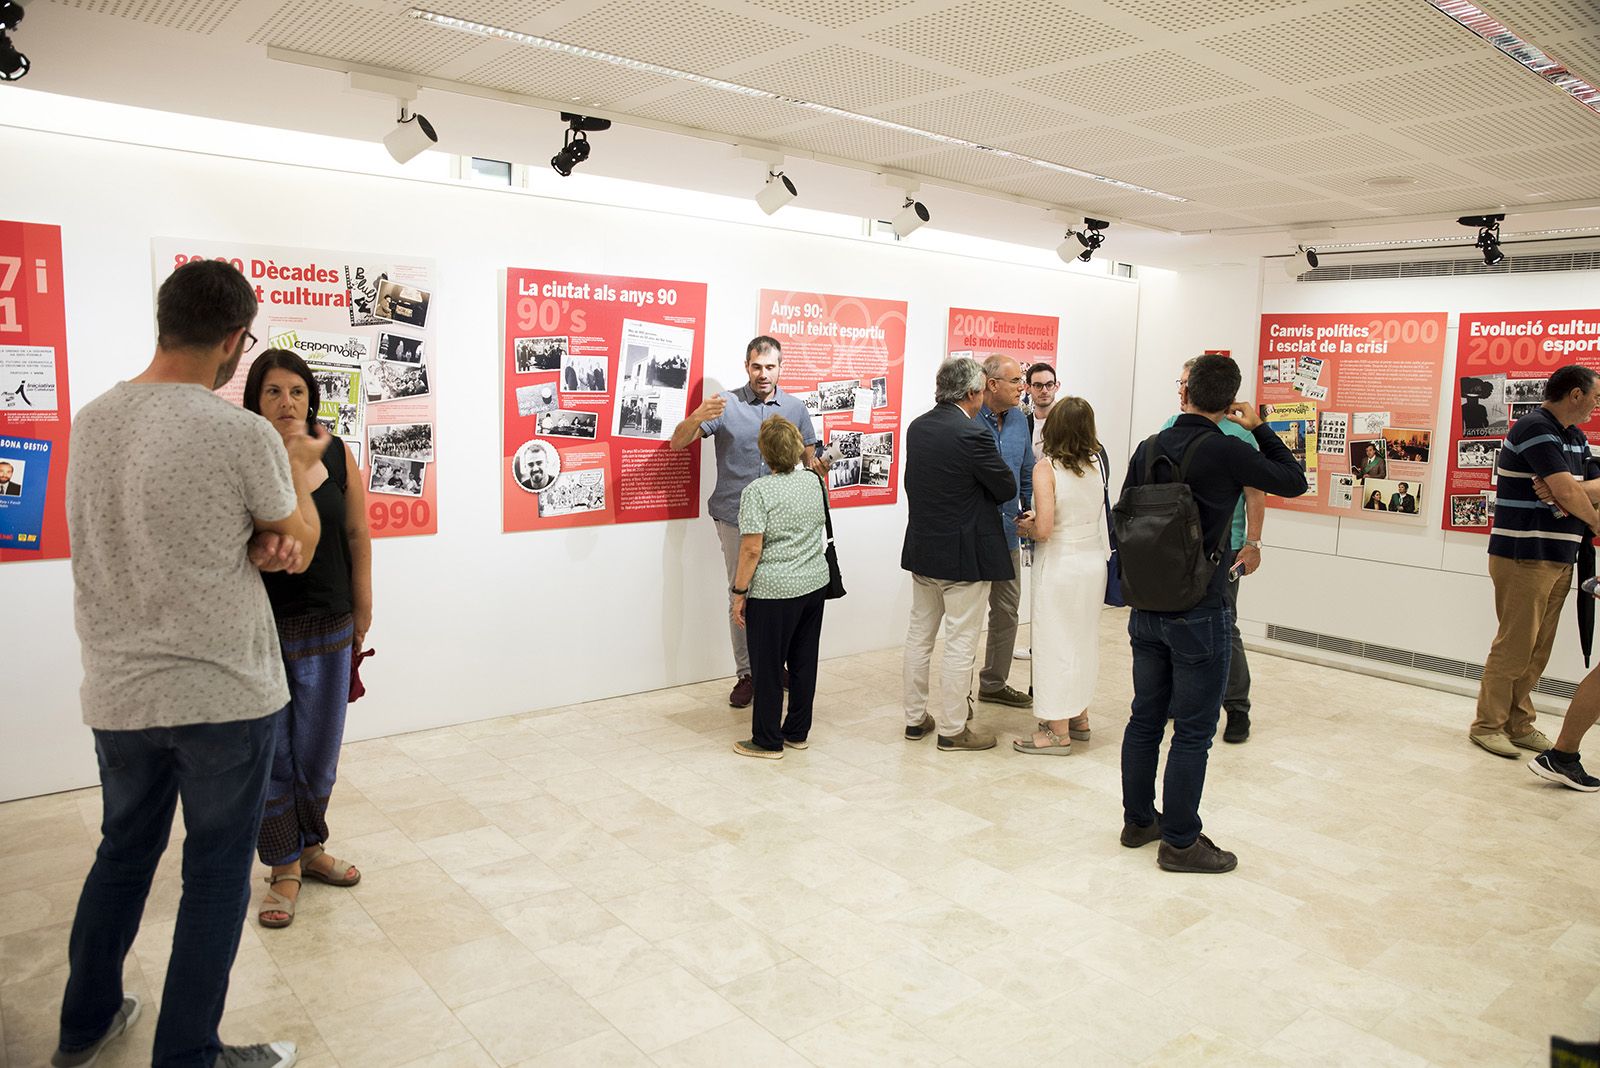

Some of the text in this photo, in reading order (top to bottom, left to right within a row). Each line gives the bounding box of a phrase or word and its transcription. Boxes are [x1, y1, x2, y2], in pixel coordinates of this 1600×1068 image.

[35, 258, 48, 294] i
[251, 259, 339, 284] Dècades
[270, 286, 351, 308] cultural
[518, 278, 678, 307] La ciutat als anys 90
[517, 297, 587, 334] 90's
[771, 301, 823, 320] Anys 90:
[769, 319, 885, 341] Ampli teixit esportiu
[953, 314, 1054, 338] 2000 Entre Internet i
[1270, 324, 1370, 340] Canvis polítics
[1367, 319, 1439, 344] 2000
[1470, 320, 1544, 337] Evolució
[964, 335, 1054, 351] els moviments socials
[1269, 340, 1388, 354] i esclat de la crisi
[1467, 336, 1561, 366] 2000
[0, 439, 49, 452] BONA GESTIÓ
[369, 500, 430, 530] 990
